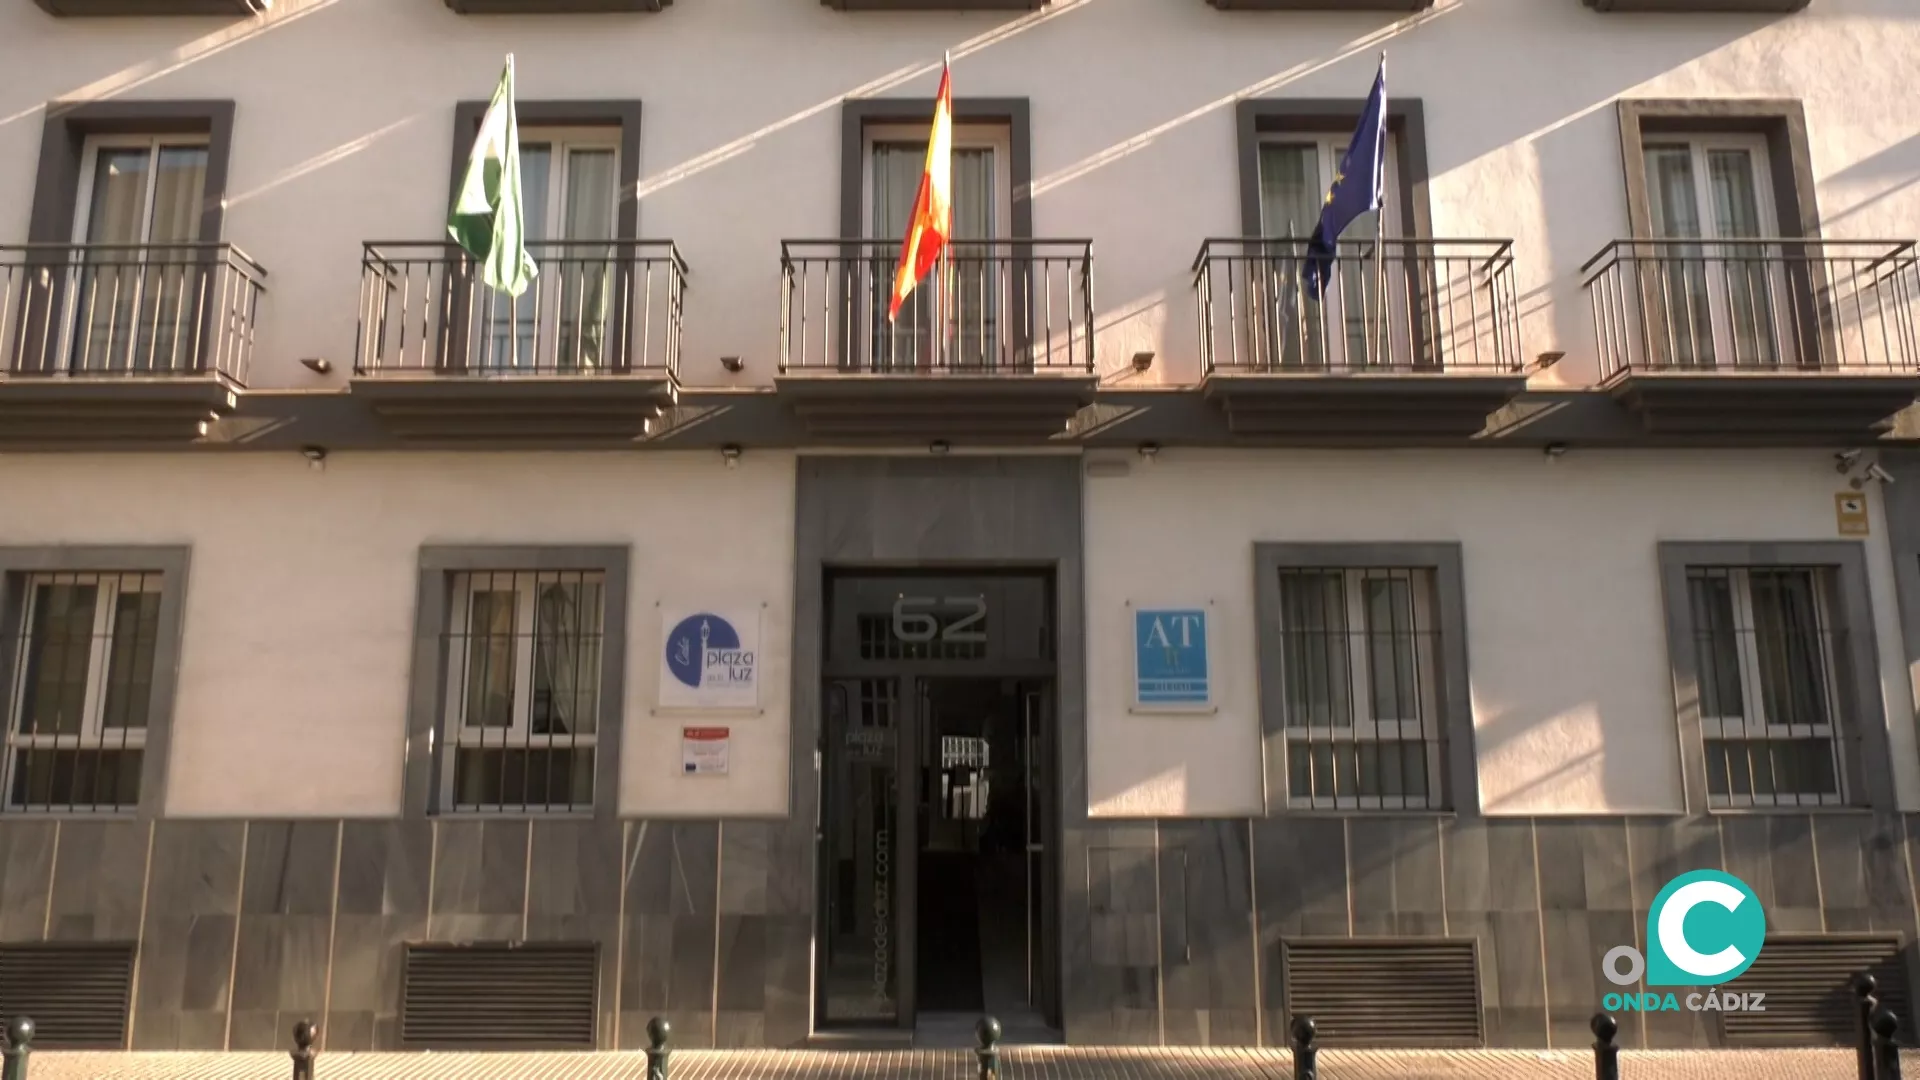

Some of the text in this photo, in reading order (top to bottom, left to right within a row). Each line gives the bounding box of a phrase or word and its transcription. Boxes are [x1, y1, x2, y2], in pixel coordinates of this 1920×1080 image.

[893, 597, 987, 642] 62
[1144, 616, 1200, 648] AT
[707, 649, 754, 669] plaza
[729, 664, 752, 681] luz
